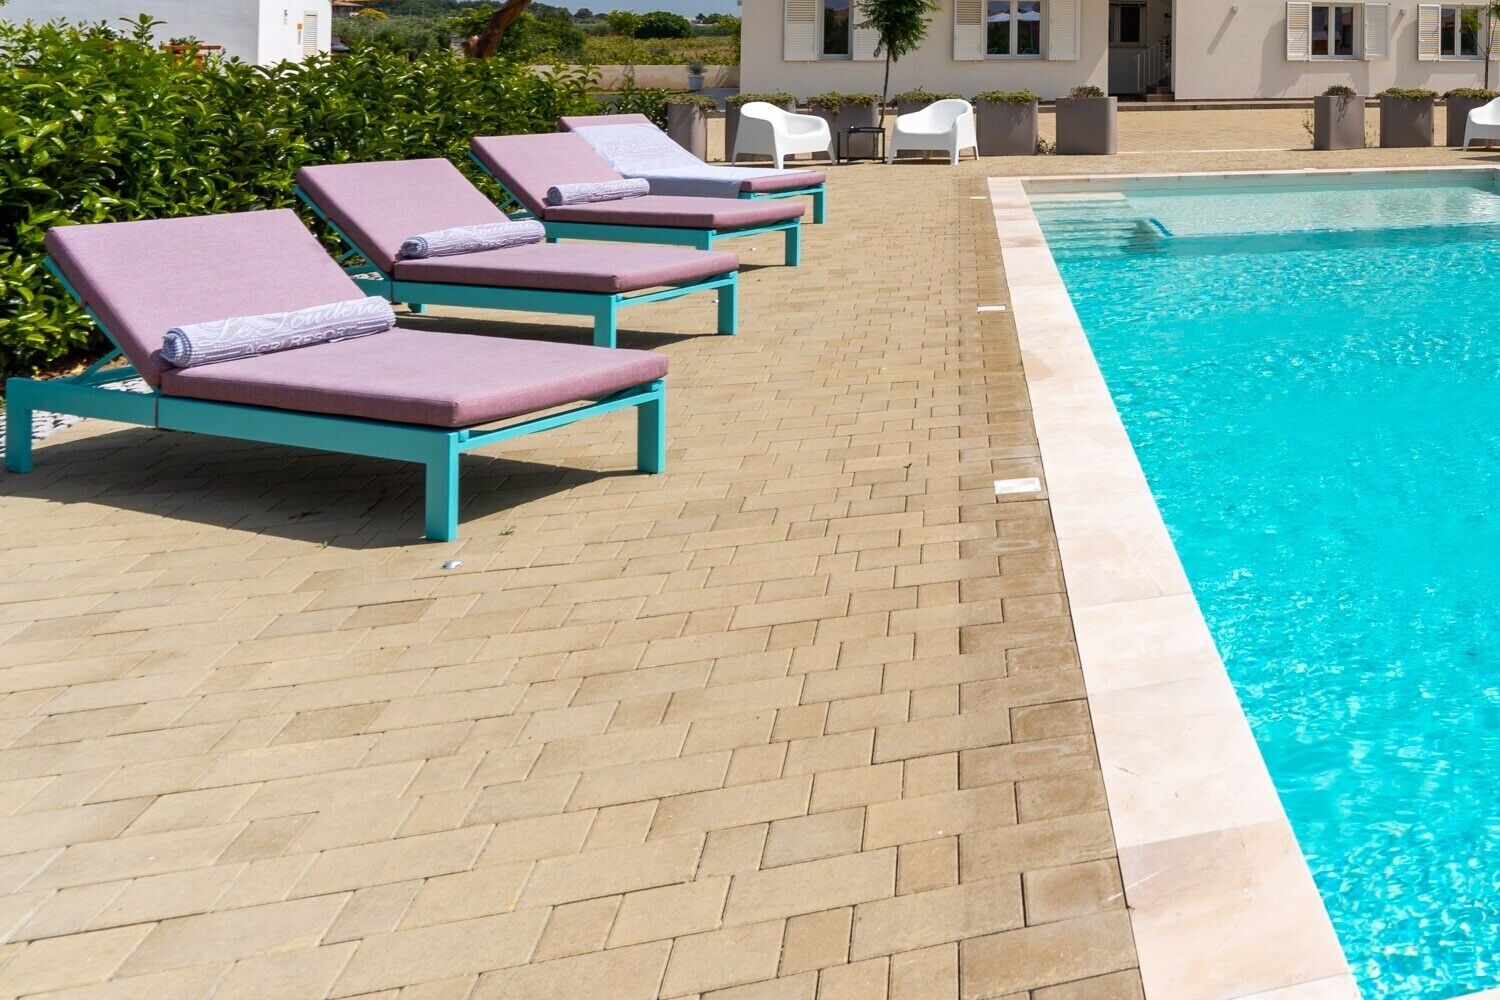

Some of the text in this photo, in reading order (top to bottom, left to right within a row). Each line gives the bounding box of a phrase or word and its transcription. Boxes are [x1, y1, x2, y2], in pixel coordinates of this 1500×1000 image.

[198, 316, 253, 347] Le
[245, 325, 357, 354] AGRI RESORT
